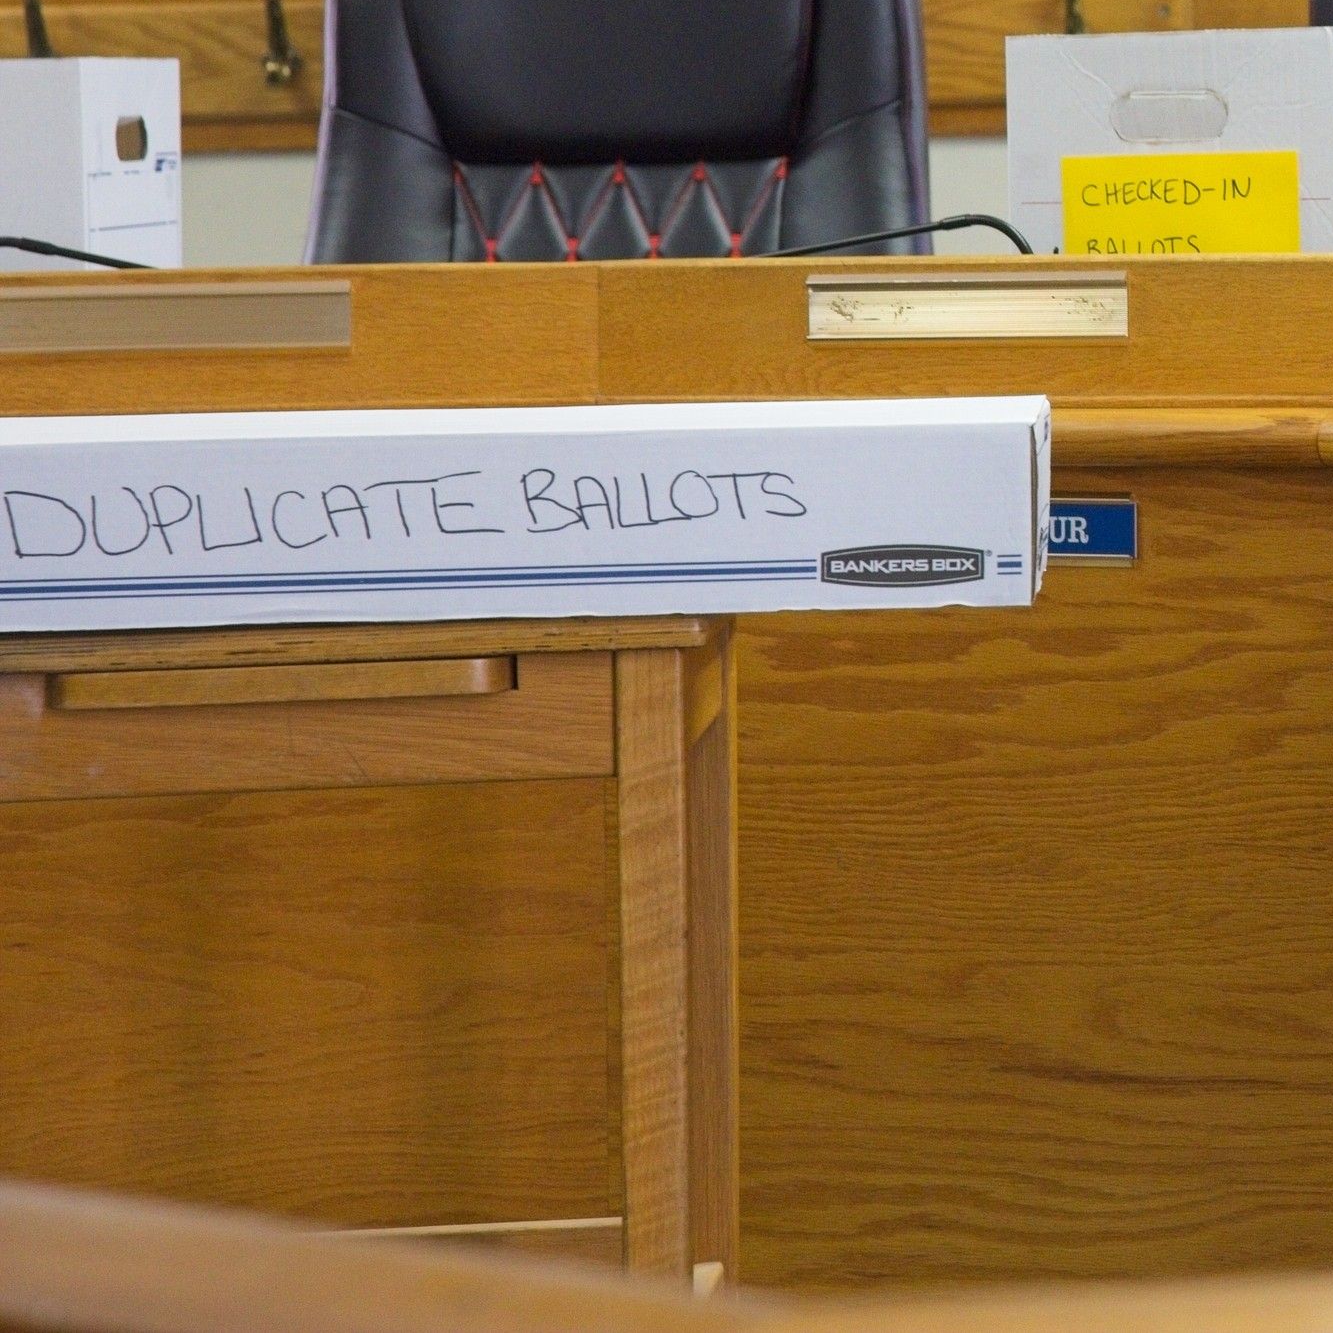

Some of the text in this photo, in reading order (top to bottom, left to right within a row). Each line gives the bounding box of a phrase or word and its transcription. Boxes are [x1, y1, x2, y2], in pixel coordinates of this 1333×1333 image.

[1081, 176, 1252, 207] CHECKED-IN
[3, 467, 809, 560] DUPLICATE BALLOTS
[1049, 516, 1090, 544] UR
[829, 555, 978, 577] BANKERS BOX
